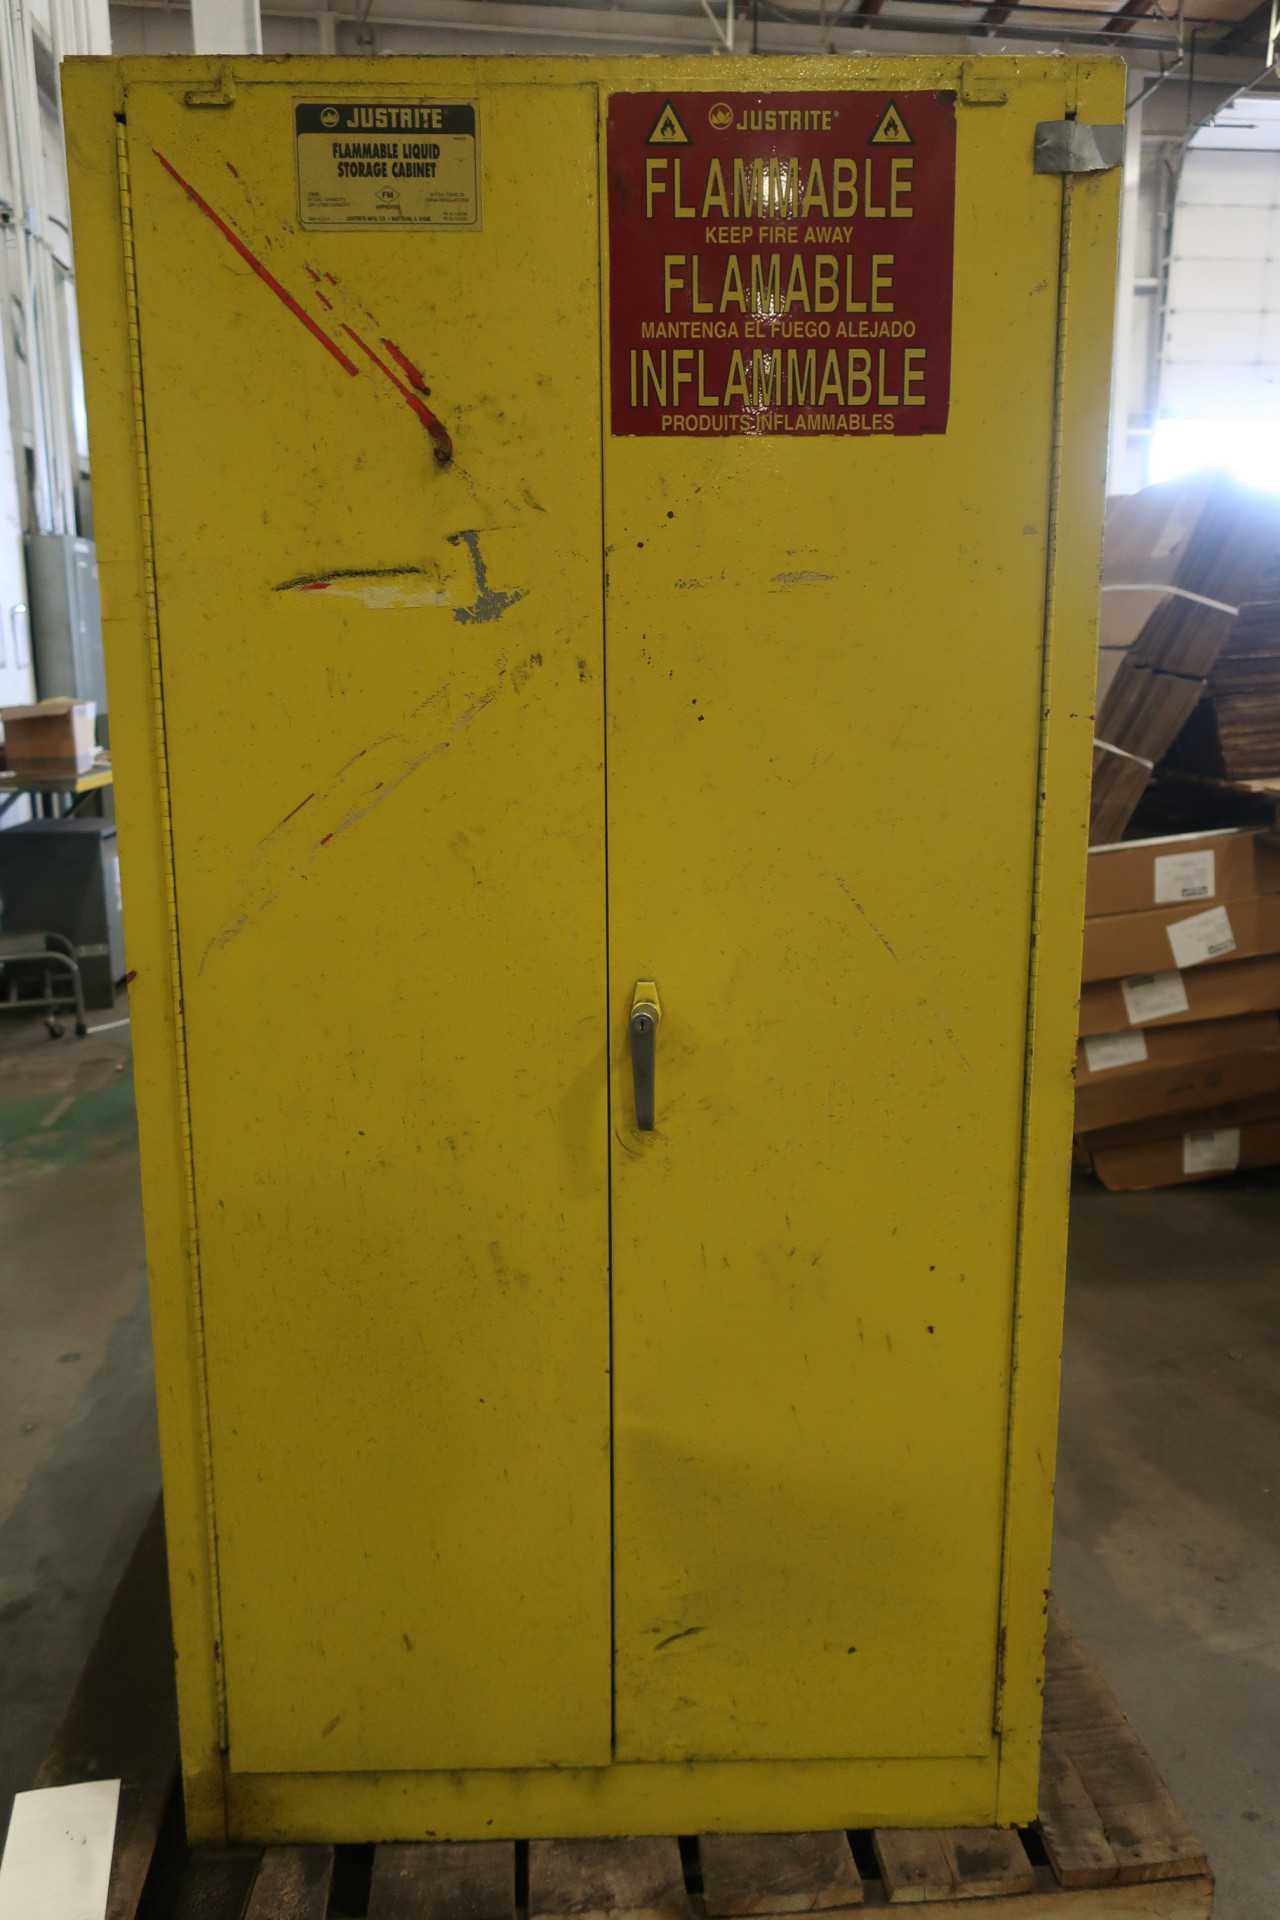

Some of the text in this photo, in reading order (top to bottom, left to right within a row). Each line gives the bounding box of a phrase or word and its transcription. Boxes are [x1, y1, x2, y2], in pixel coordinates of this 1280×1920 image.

[346, 107, 443, 129] JUSTRITE
[736, 110, 832, 131] JUSTRITE
[332, 143, 441, 159] FLAMMABLE LIQUID
[337, 161, 437, 178] STORAGE CABINET
[645, 157, 914, 219] FLAMMABLE
[705, 226, 854, 244] KEEP FIRE AWAY
[663, 254, 895, 313] FLAMABLE
[641, 320, 917, 339] MANTENGA EL FUEGO ALEJADO
[630, 348, 927, 408] INFLAMMABLE
[661, 414, 895, 432] PRODUITS INFLAMMABLES
